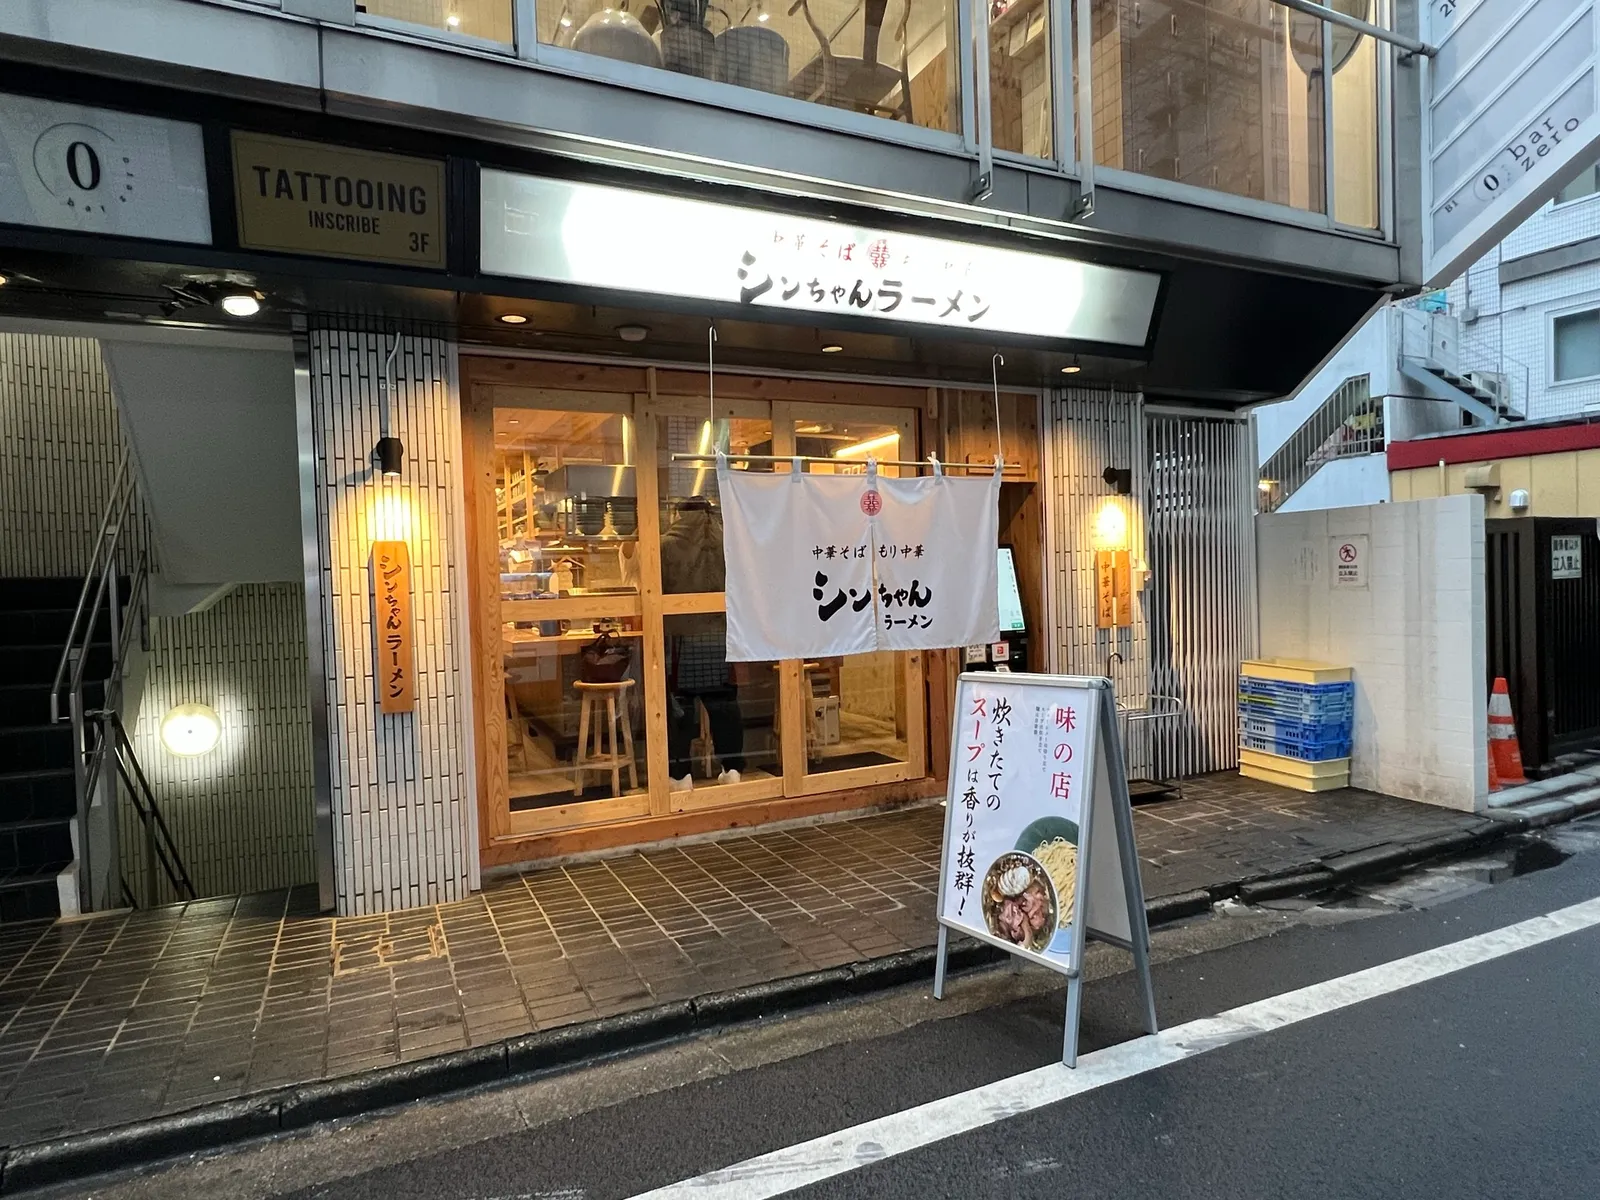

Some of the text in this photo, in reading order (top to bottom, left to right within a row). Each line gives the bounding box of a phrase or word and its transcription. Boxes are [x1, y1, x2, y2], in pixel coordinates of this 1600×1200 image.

[1507, 116, 1555, 161] bar
[1521, 116, 1580, 172] zero
[251, 164, 428, 217] TATTOOING
[308, 210, 381, 236] INSCRIBE
[408, 232, 430, 254] 3F
[737, 249, 991, 323] シンちゃんラーメン
[811, 543, 926, 561] 中華そば もり中華
[1552, 554, 1581, 572] 立入禁止
[813, 570, 933, 622] シンちゃん
[1101, 561, 1111, 618] 中華そば
[379, 555, 404, 698] シンちゃんラーメン
[884, 615, 933, 630] ラーメン
[986, 697, 1012, 811] 炊きたての
[1050, 705, 1077, 801] 味の店
